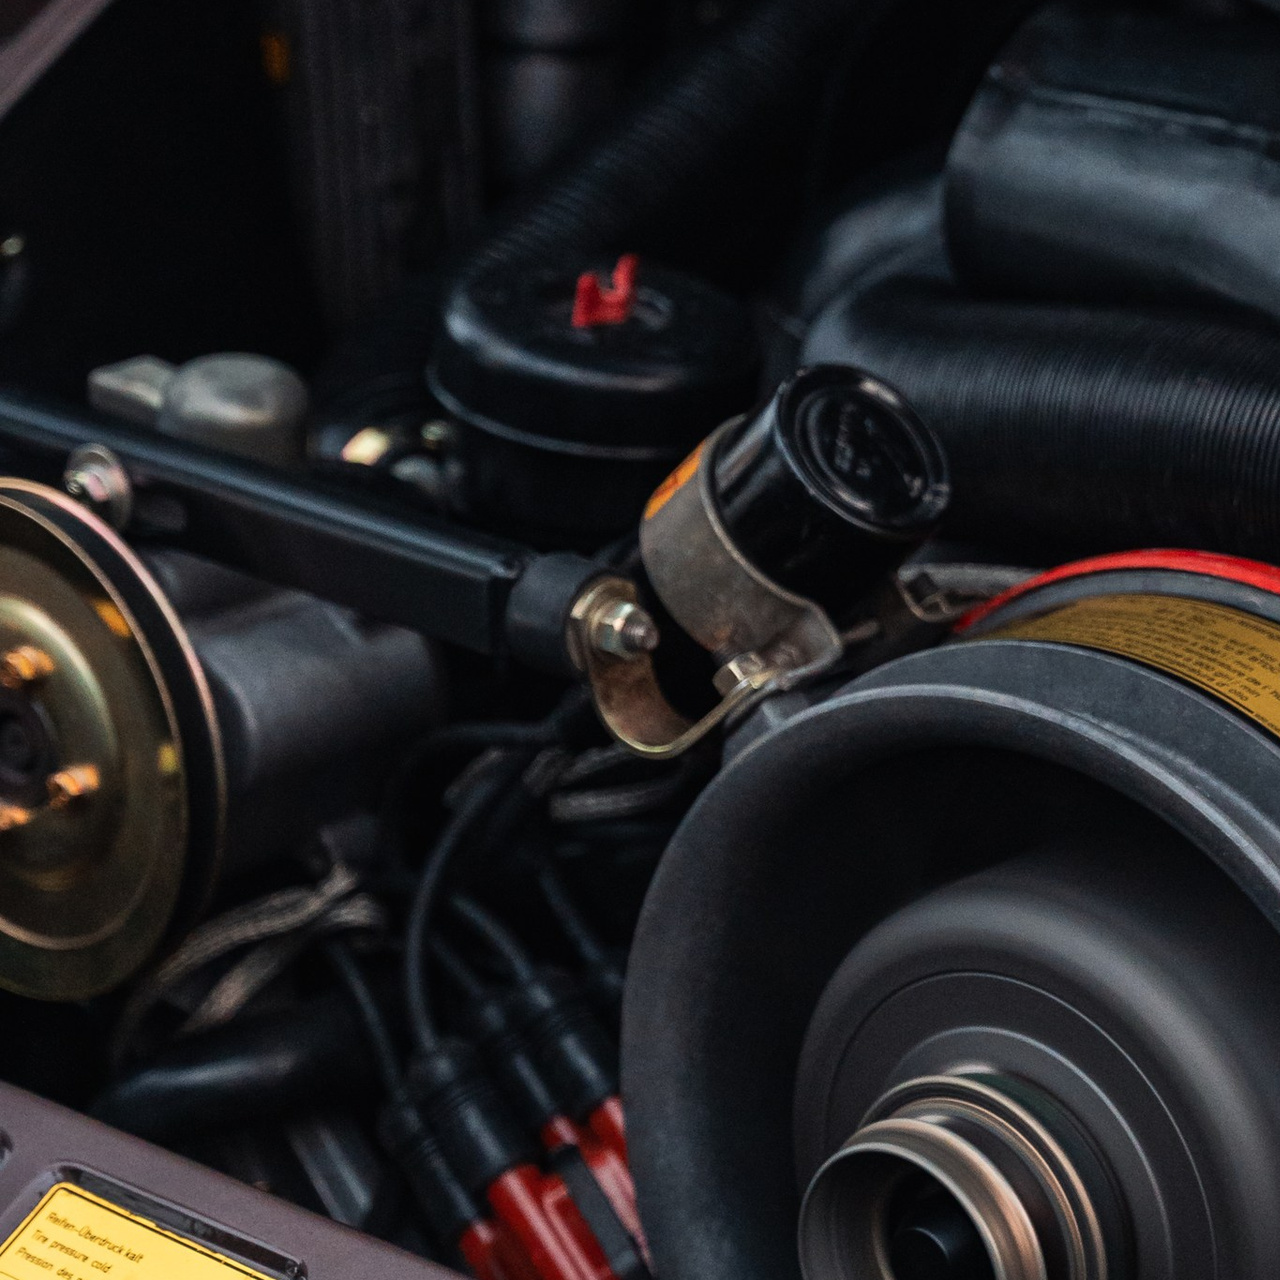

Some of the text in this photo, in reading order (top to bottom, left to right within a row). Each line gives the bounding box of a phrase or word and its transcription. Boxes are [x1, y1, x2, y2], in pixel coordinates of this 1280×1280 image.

[16, 1246, 53, 1270] Pression
[56, 1268, 73, 1280] des
[49, 1241, 88, 1262] pressure
[91, 1260, 112, 1273] cold
[124, 1249, 143, 1262] kalt
